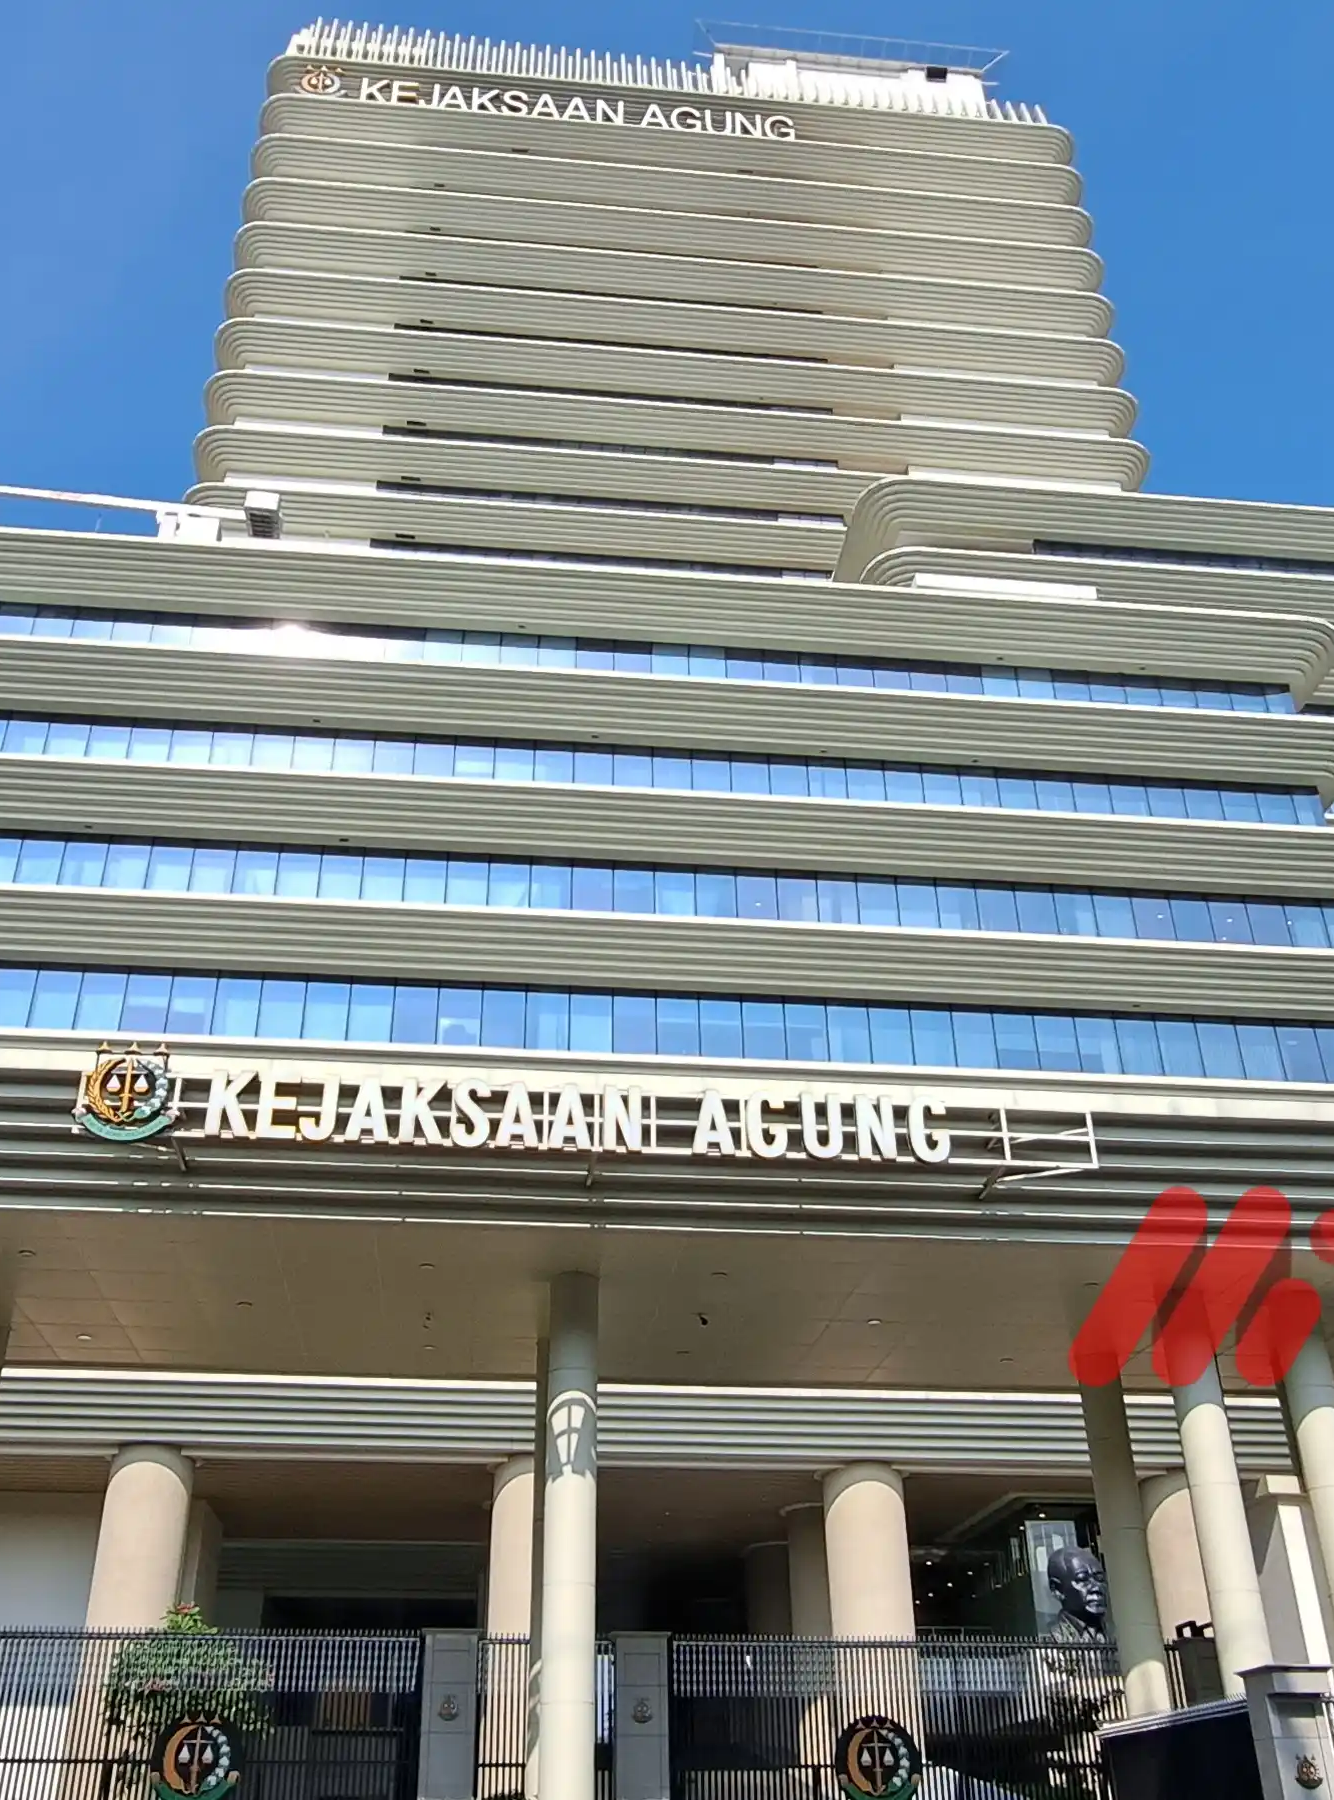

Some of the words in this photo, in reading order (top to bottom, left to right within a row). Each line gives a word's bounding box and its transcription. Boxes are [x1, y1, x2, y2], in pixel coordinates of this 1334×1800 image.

[359, 77, 625, 125] KEJAKSAAN
[640, 104, 797, 141] AGUNG
[204, 1069, 643, 1153] KEJAKSAAN
[691, 1089, 952, 1164] AGUNG
